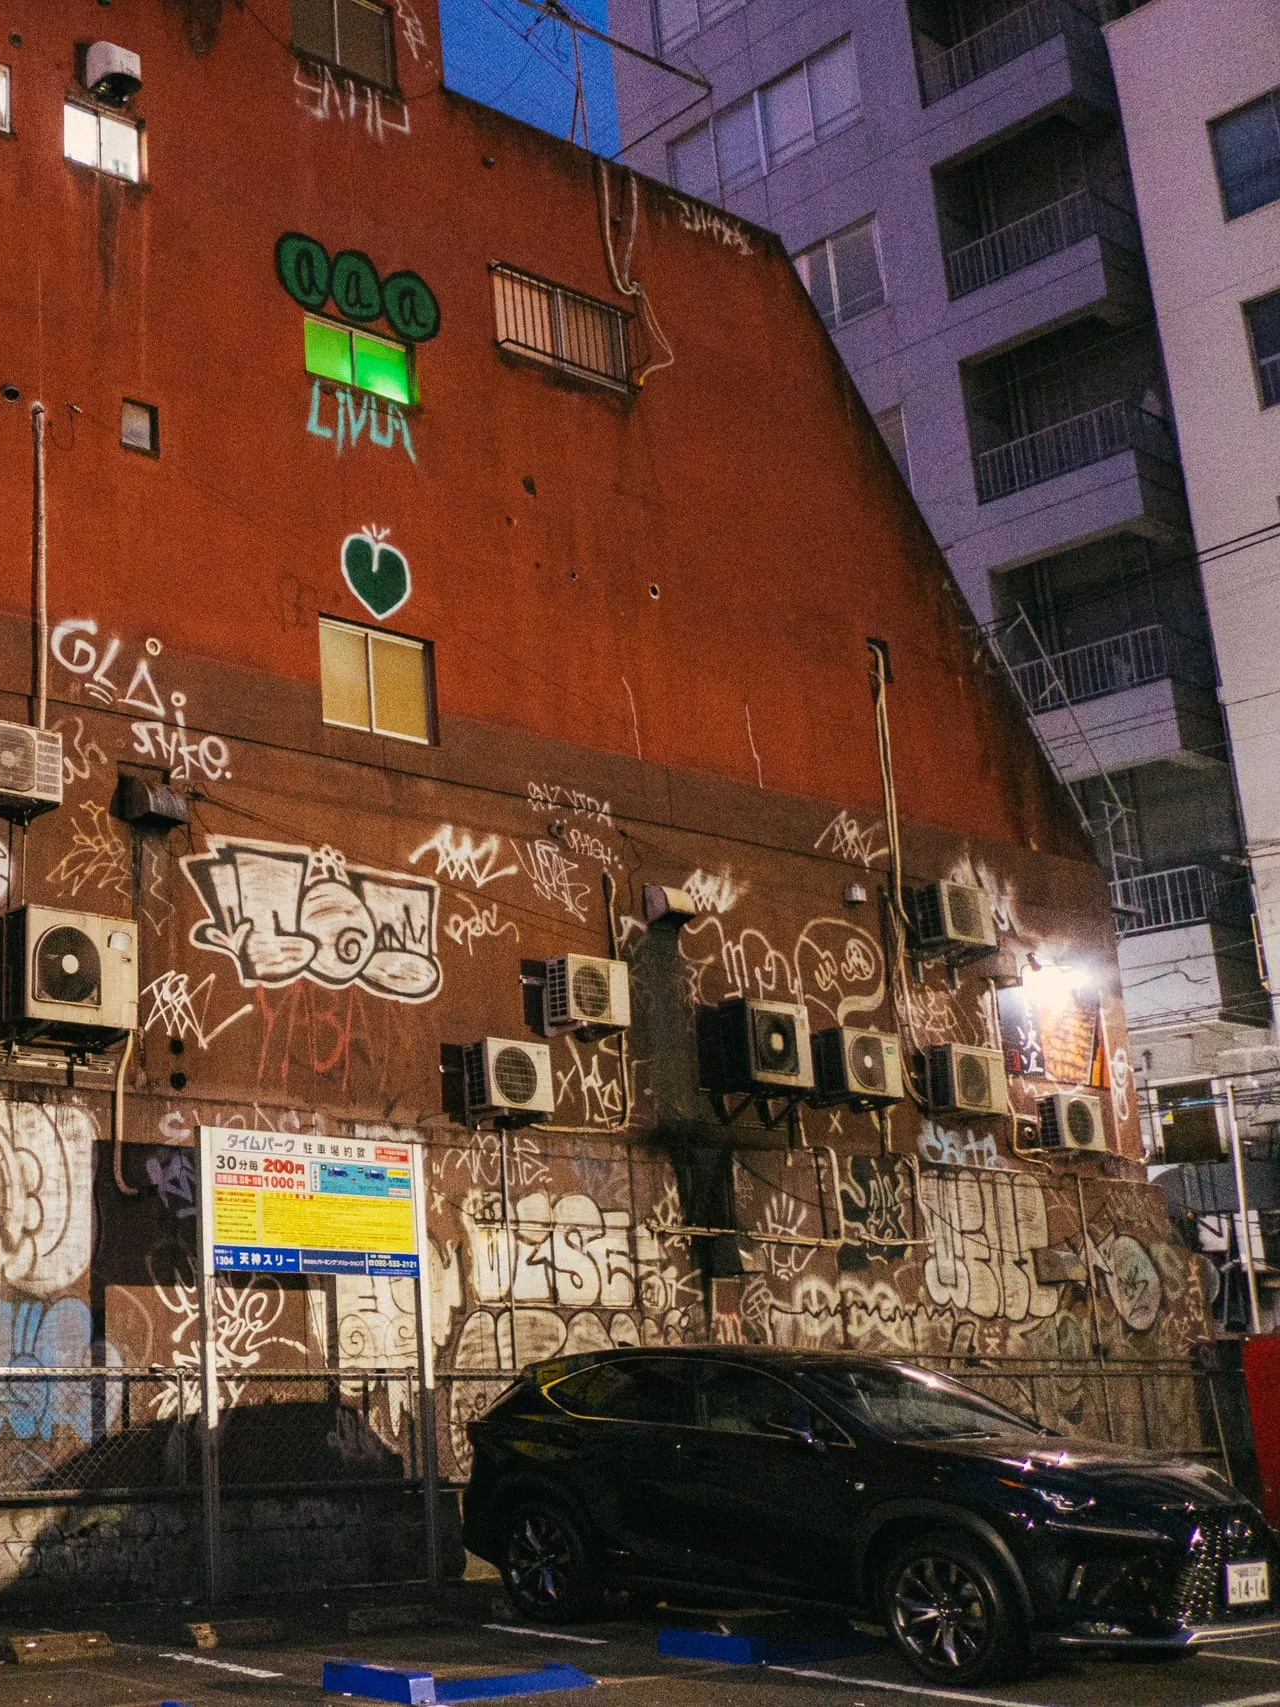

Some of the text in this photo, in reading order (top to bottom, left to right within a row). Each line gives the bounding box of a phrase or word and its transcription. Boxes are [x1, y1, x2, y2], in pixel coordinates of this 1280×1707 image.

[227, 1132, 295, 1153] タイムパーク
[263, 1157, 305, 1175] 200円
[264, 1175, 306, 1190] 1000円
[239, 1252, 295, 1266] 天神スリー
